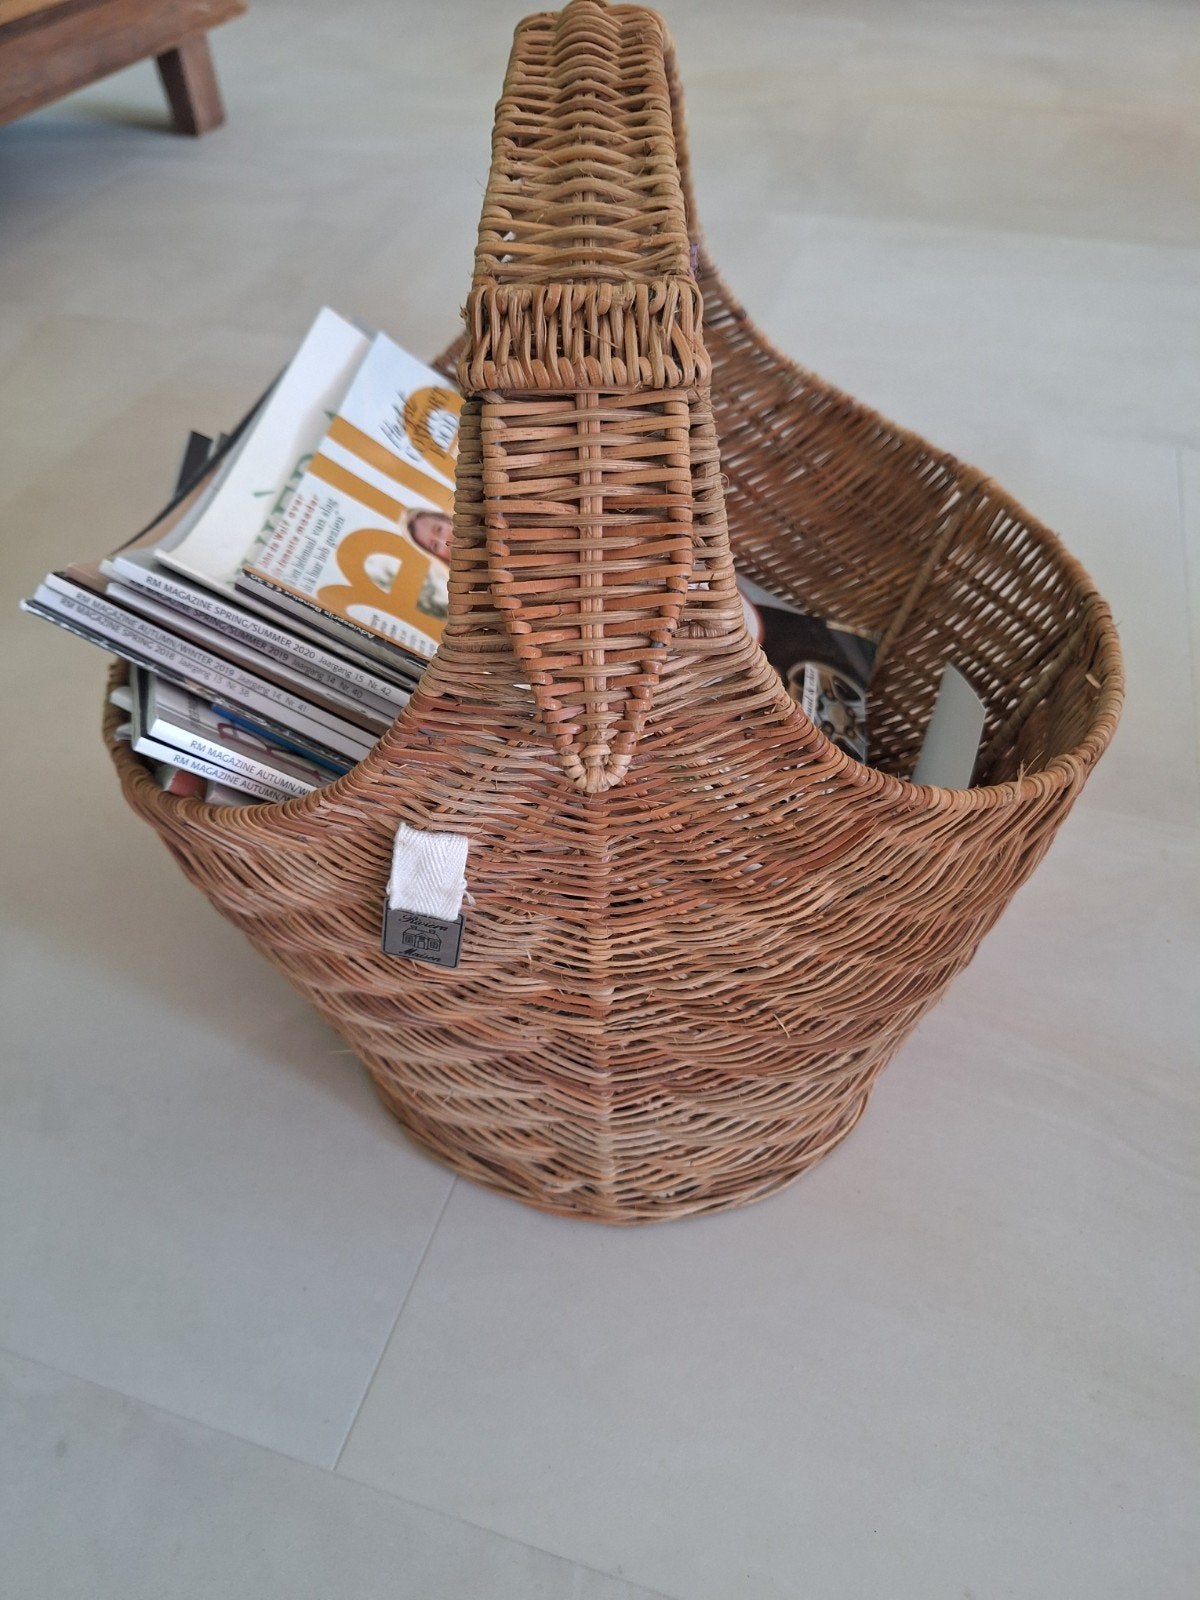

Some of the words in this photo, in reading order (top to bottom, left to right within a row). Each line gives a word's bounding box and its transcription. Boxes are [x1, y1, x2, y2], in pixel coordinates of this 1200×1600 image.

[289, 495, 303, 518] over
[296, 494, 318, 534] moeder
[317, 498, 338, 518] slag
[312, 519, 325, 535] van
[293, 535, 316, 569] helemaal
[60, 597, 75, 608] RM
[76, 604, 121, 633] MAGAZINE
[121, 628, 153, 649] SPRING
[154, 645, 175, 661] 2018
[178, 656, 211, 680] Jaargang
[238, 687, 250, 698] 38
[76, 592, 90, 603] RM
[91, 600, 137, 626] MAGAZINE
[138, 622, 213, 665] AUTUMN/WINTER
[215, 662, 235, 677] 2019
[238, 673, 271, 696] Jaargang
[272, 690, 282, 700] 14
[297, 703, 307, 713] 41
[146, 576, 162, 588] RM
[164, 584, 213, 611] MAGAZINE
[215, 607, 292, 647] SPRING/SUMMER
[293, 640, 316, 659] 2020
[318, 656, 353, 679] Jaargang
[354, 673, 365, 683] 15
[380, 686, 392, 697] 42
[193, 609, 266, 650] SPRING/SUMMER
[268, 646, 289, 661] 2019
[292, 658, 324, 681] Jaargang
[325, 675, 336, 684] 14
[351, 688, 363, 699] 40
[173, 754, 189, 766] RM
[190, 761, 242, 786] MAGAZINE
[190, 740, 207, 752] RM
[207, 747, 256, 773] MAGAZINE
